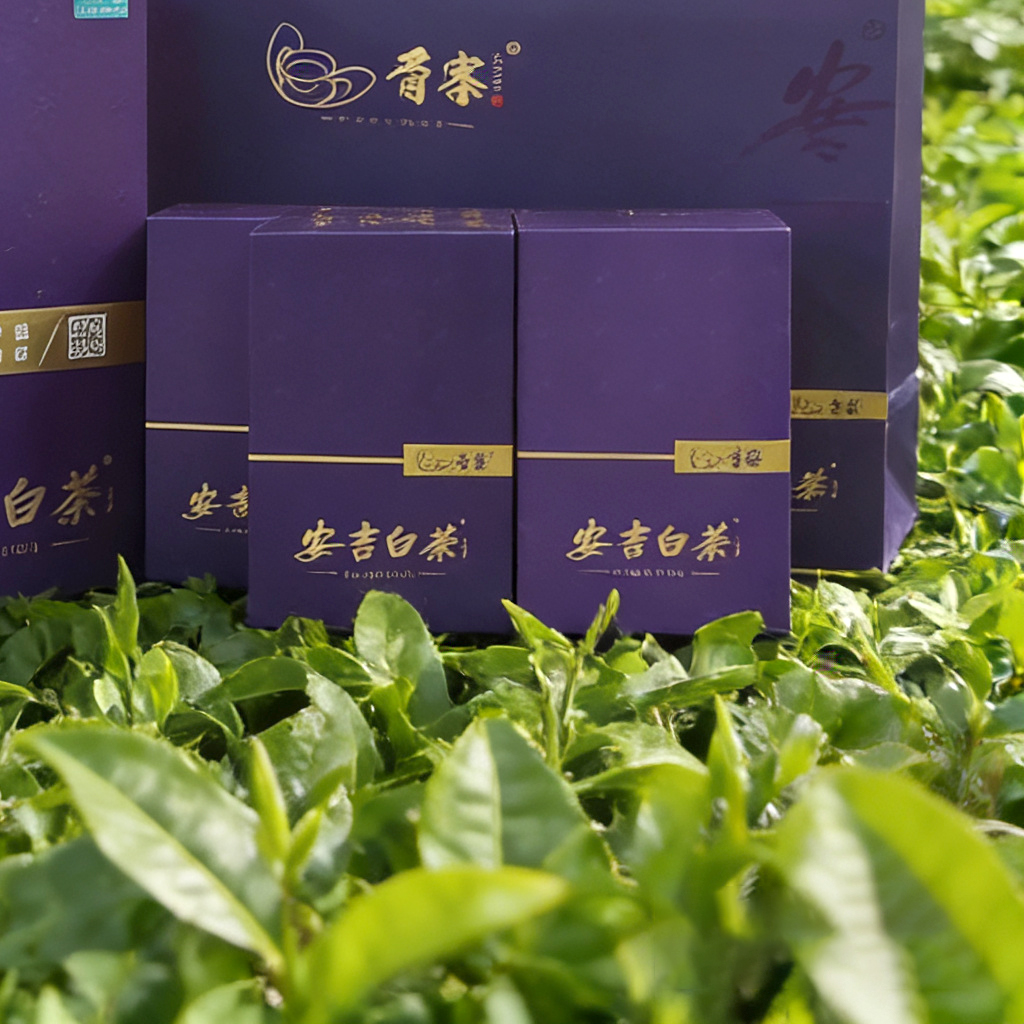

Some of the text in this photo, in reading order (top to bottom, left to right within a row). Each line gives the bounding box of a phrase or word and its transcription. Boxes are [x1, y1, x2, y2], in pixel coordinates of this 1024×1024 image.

[293, 518, 458, 563] 安吉白茶
[565, 517, 731, 562] 安吉白茶
